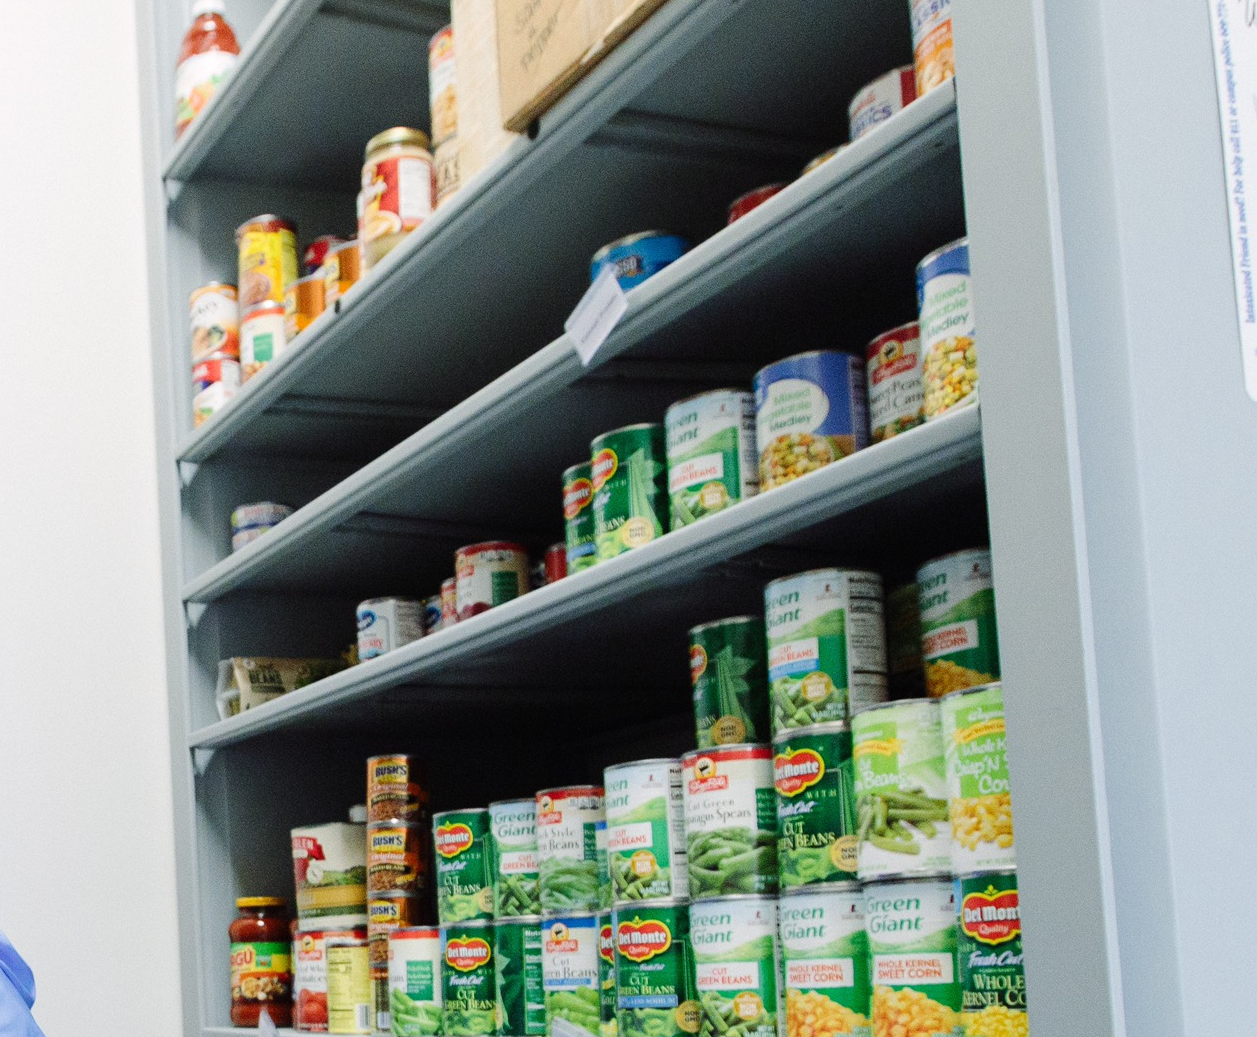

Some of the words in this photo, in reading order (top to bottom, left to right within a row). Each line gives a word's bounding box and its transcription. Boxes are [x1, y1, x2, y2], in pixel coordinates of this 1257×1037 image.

[769, 414, 811, 433] Medley
[375, 764, 407, 778] BUSH'S
[784, 761, 820, 777] Monte
[806, 789, 837, 799] WITH
[716, 808, 752, 824] Spears
[498, 823, 536, 838] Giant
[783, 821, 805, 835] CUT
[372, 834, 403, 846] BUSH'S
[445, 831, 469, 844] Monte
[796, 831, 836, 847] BEANS
[549, 838, 580, 851] Beans
[453, 882, 481, 895] BEANS
[370, 904, 397, 916] BUSH'S
[964, 907, 980, 922] Del
[870, 915, 924, 933] Giant
[978, 923, 1009, 936] Quality
[618, 933, 631, 944] Del
[632, 931, 666, 943] Monte
[694, 930, 733, 945] Giant
[448, 947, 460, 957] Del
[460, 946, 487, 957] Monte
[552, 956, 570, 966] Cut
[878, 960, 903, 969] WHOLE
[905, 958, 941, 969] KERNEL
[563, 969, 597, 979] Beans
[712, 967, 727, 975] CUT
[812, 963, 843, 973] KERNEL
[878, 970, 905, 979] SWEET
[908, 968, 942, 979] CORN
[629, 974, 650, 985] CUT
[721, 975, 753, 984] BEANS
[813, 972, 844, 983] CORN
[457, 989, 476, 1000] CUT
[641, 984, 676, 995] BEANS
